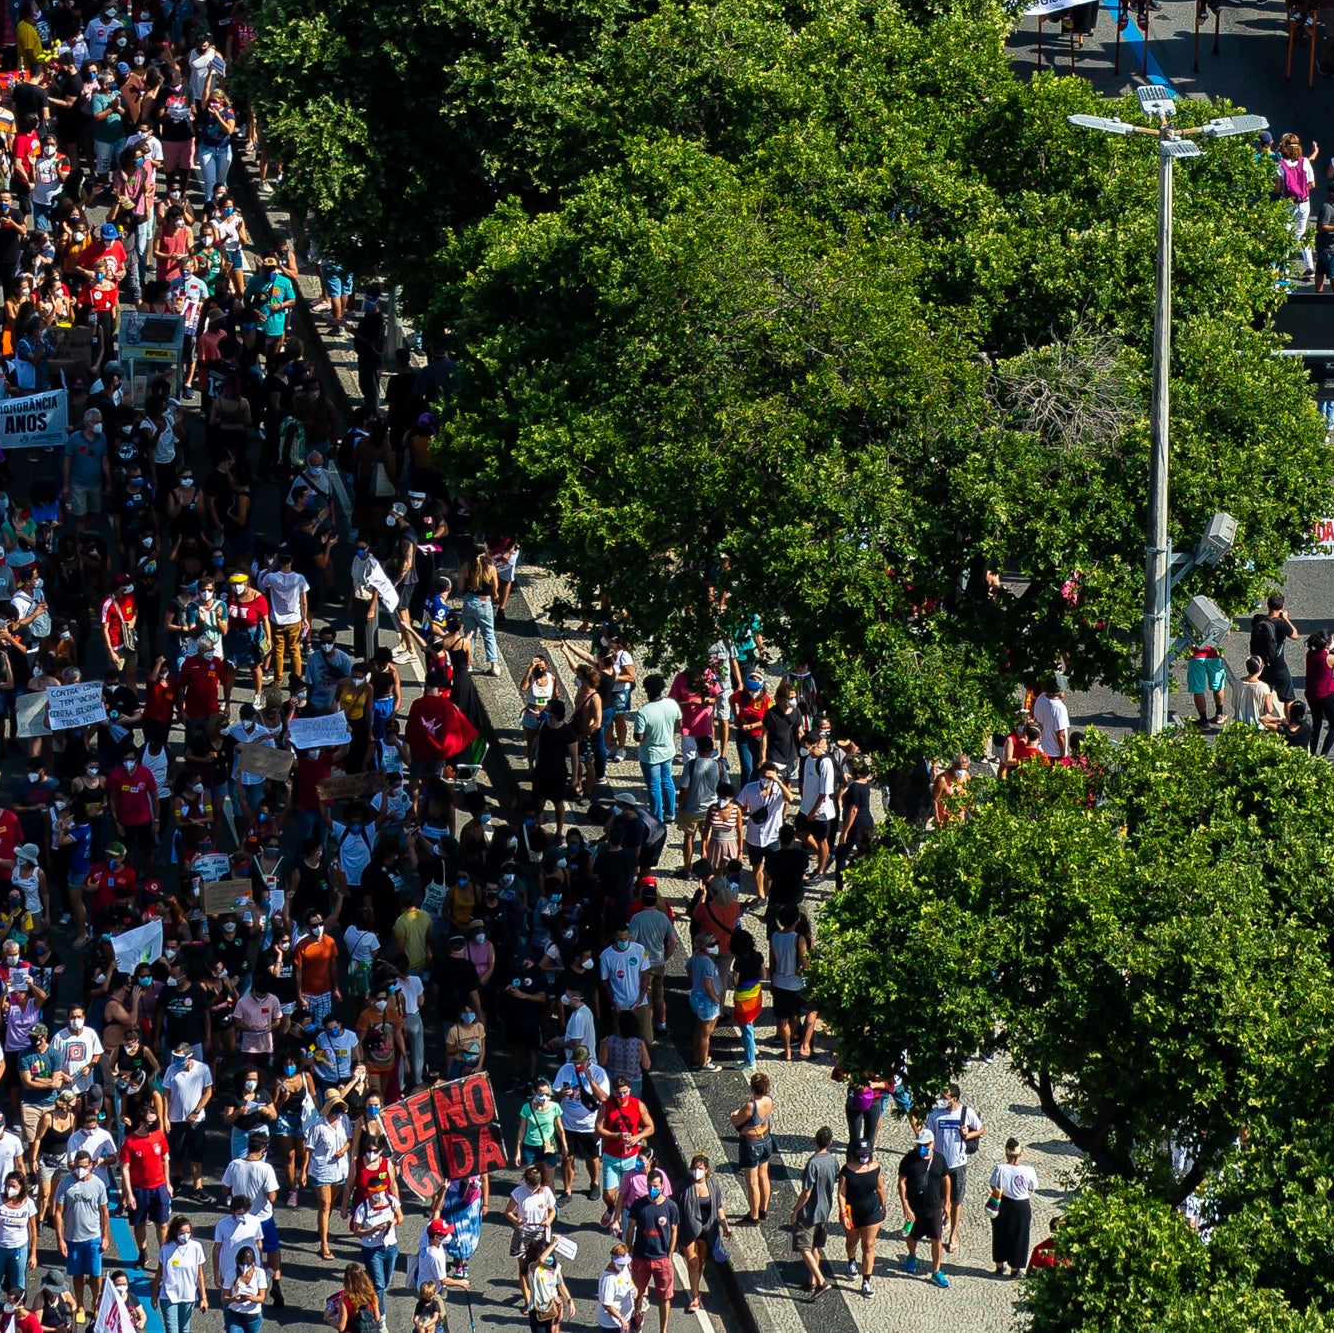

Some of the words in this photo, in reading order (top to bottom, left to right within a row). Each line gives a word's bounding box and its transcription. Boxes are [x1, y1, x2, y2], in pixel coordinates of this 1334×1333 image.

[0, 396, 58, 416] IGNORÂNCIA
[4, 413, 48, 435] ANOS
[389, 1078, 492, 1151] GENO
[399, 1125, 506, 1199] CIDA
